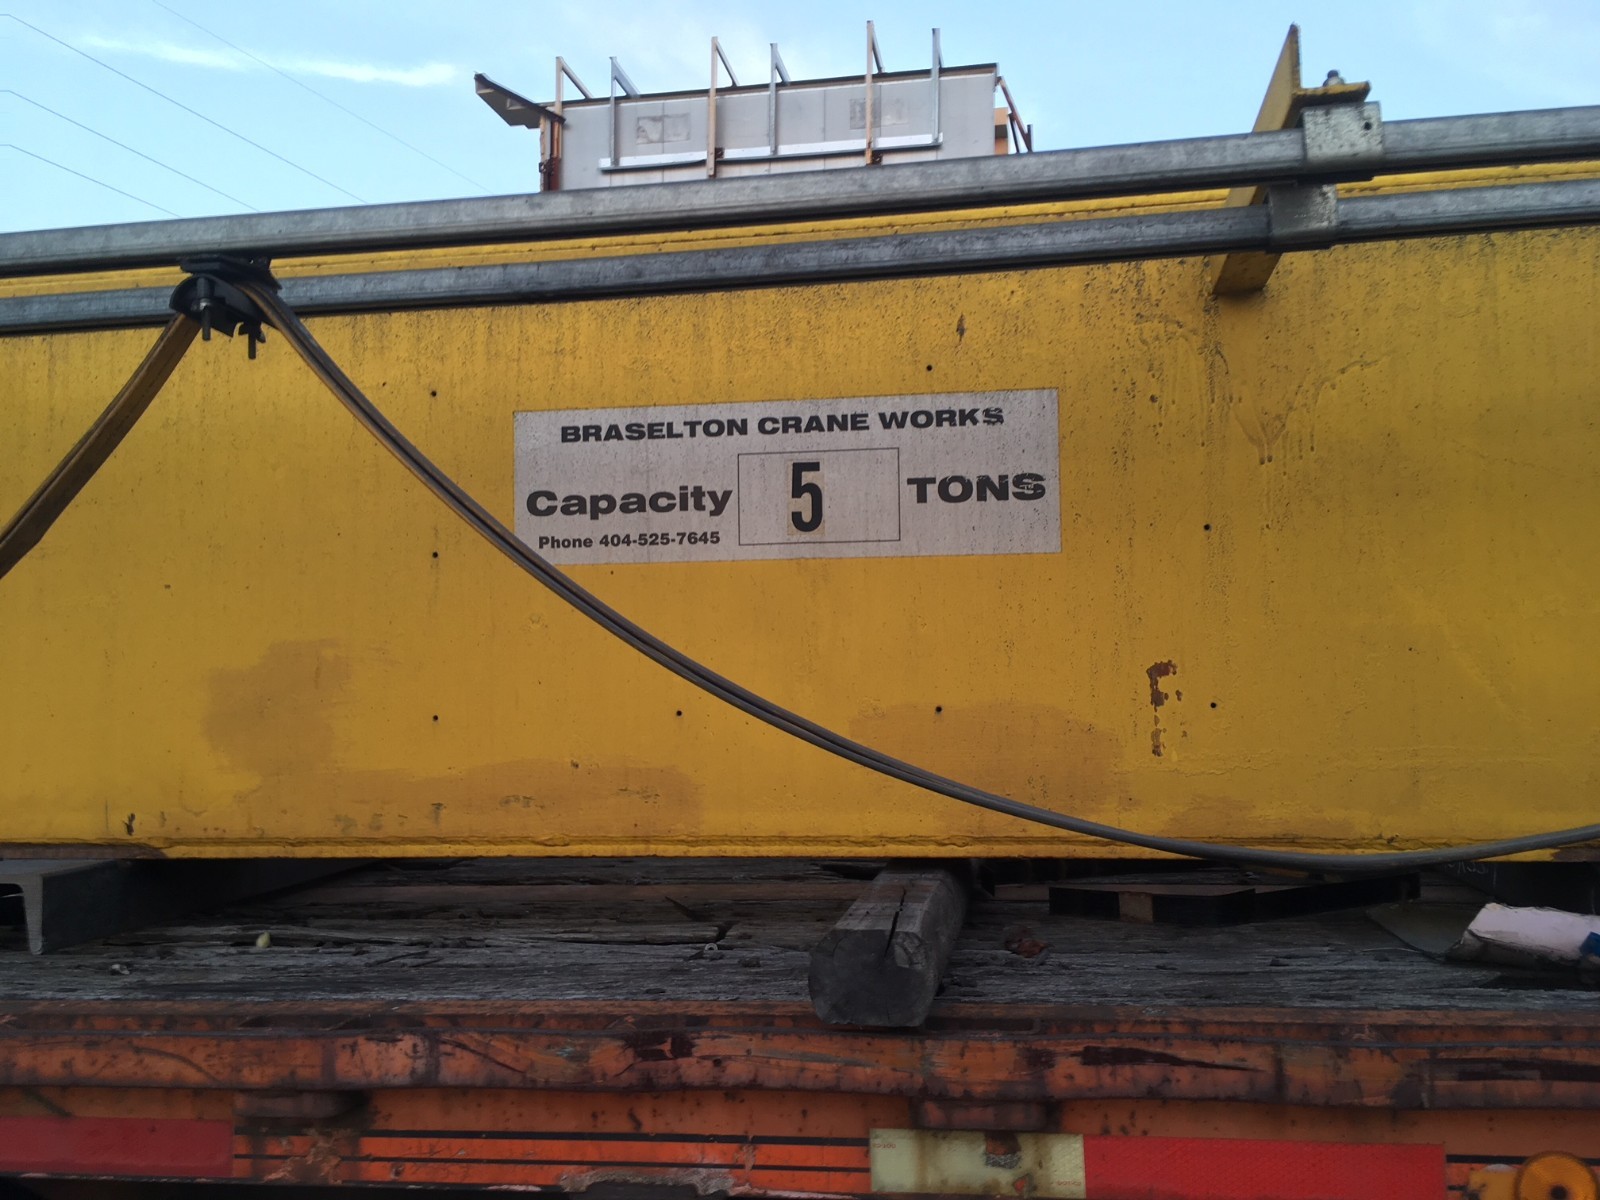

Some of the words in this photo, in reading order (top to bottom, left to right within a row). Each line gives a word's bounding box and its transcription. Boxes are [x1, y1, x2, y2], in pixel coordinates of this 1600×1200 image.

[560, 418, 748, 443] BRASELTON
[757, 411, 870, 435] CRANE
[878, 407, 1005, 430] WORKS
[526, 485, 733, 520] Capacity
[791, 461, 824, 532] 5
[907, 472, 1047, 504] TONS
[538, 535, 594, 549] Phone
[599, 531, 721, 547] 404-525-7645
